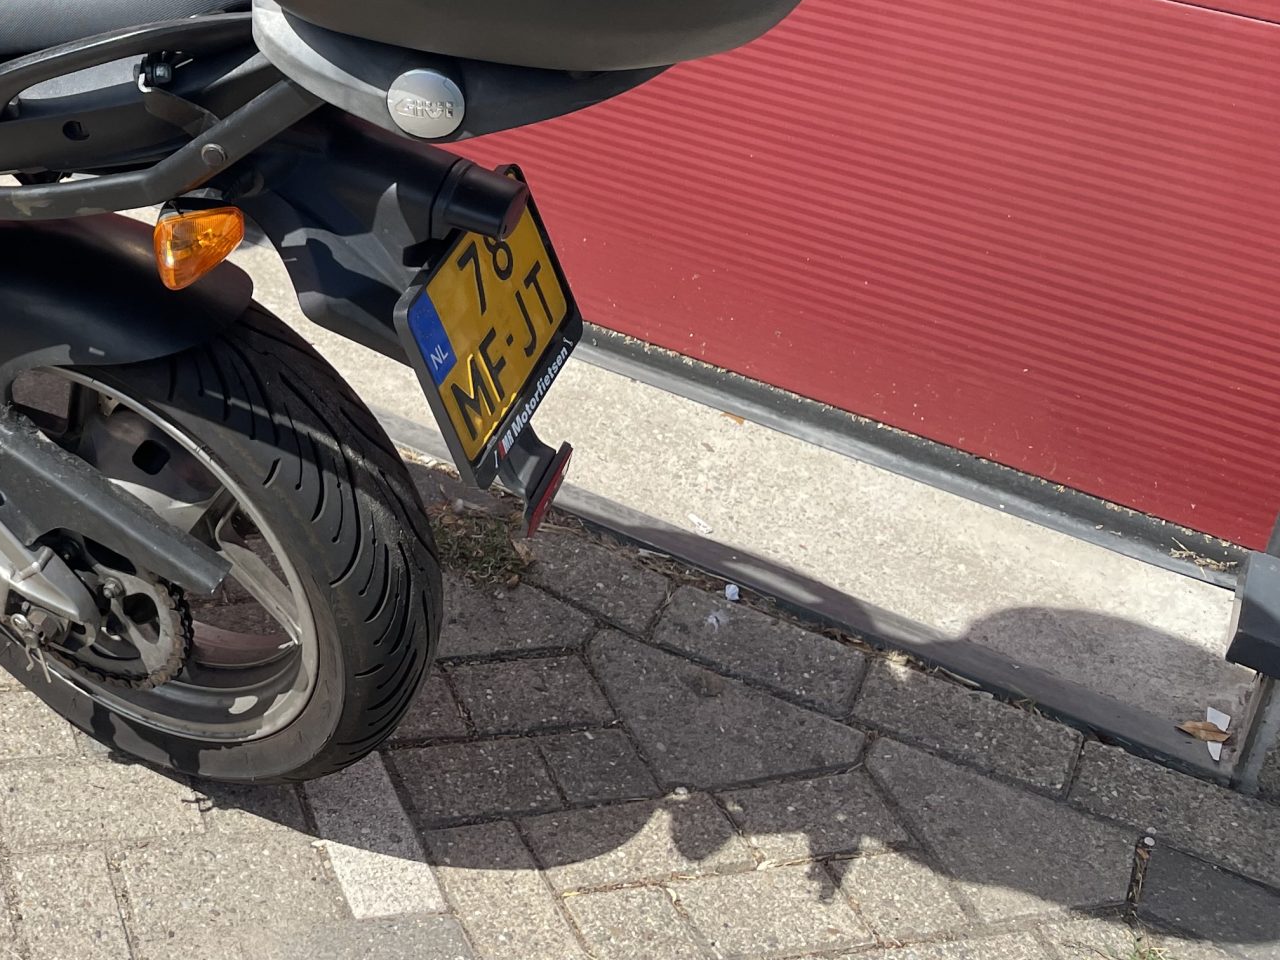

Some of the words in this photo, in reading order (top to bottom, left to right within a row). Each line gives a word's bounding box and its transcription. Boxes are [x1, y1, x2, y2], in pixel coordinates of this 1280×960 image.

[456, 235, 514, 316] 78
[430, 344, 449, 371] NL
[450, 260, 555, 439] MF-JT
[511, 346, 568, 437] Motorfietsen
